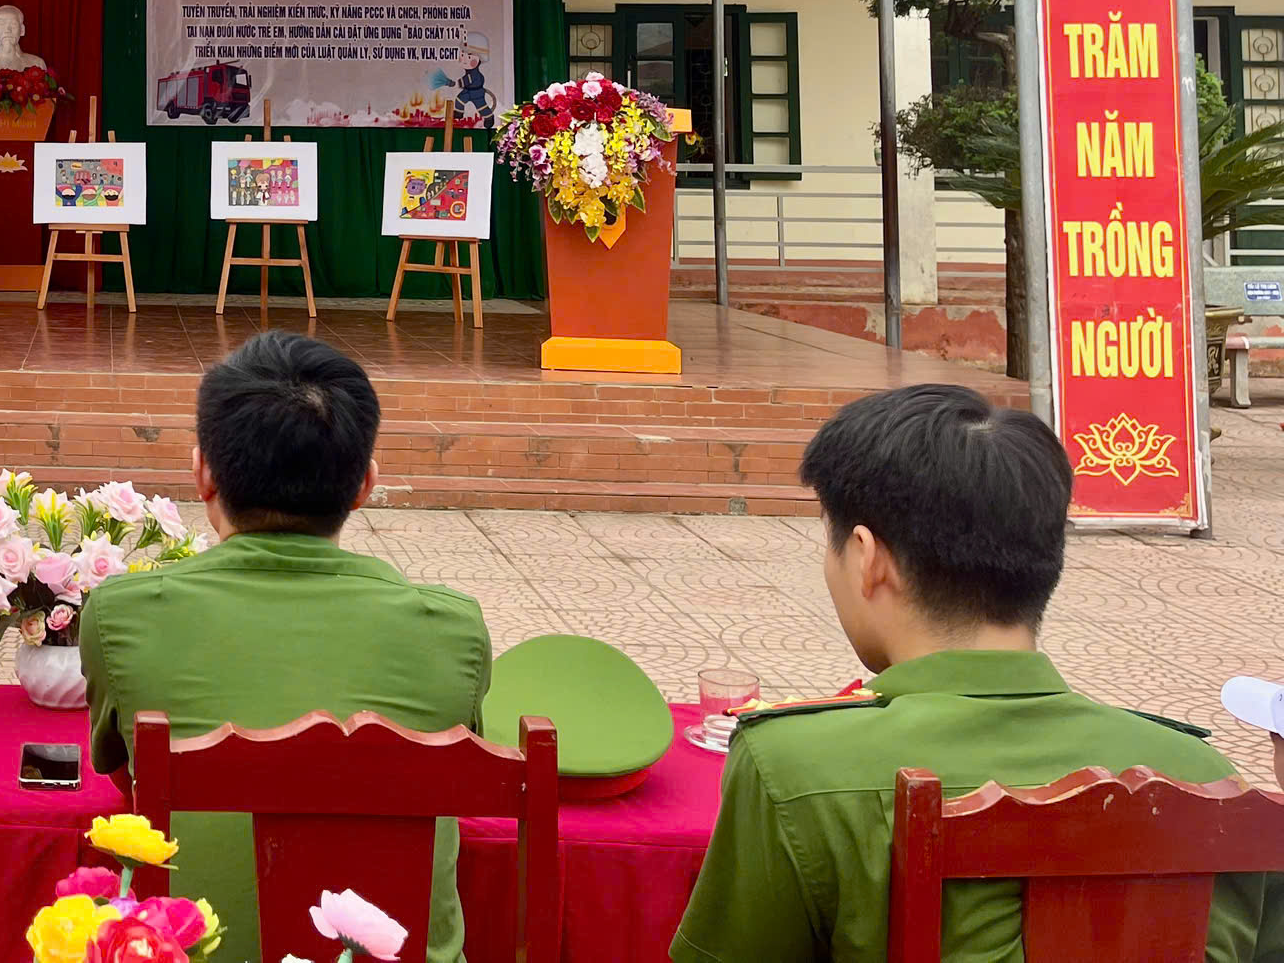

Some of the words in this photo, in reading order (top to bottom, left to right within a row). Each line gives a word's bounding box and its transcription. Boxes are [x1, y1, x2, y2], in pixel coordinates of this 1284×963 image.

[182, 4, 205, 18] TUYÊN
[257, 3, 286, 21] NGHIỆM
[364, 6, 384, 19] PCCC
[187, 26, 197, 38] TAI
[199, 25, 214, 40] NẠN
[273, 26, 287, 39] EM,
[381, 26, 401, 41] DỤNG
[1063, 10, 1160, 79] TRĂM
[217, 45, 234, 58] KHAI
[301, 42, 316, 59] CỦA
[317, 44, 336, 61] LUẬT
[385, 47, 405, 61] DỤNG
[439, 47, 459, 60] CCHT
[1076, 109, 1156, 178] NĂM
[1062, 201, 1175, 279] TRỒNG
[1070, 306, 1175, 379] NGƯỜI
